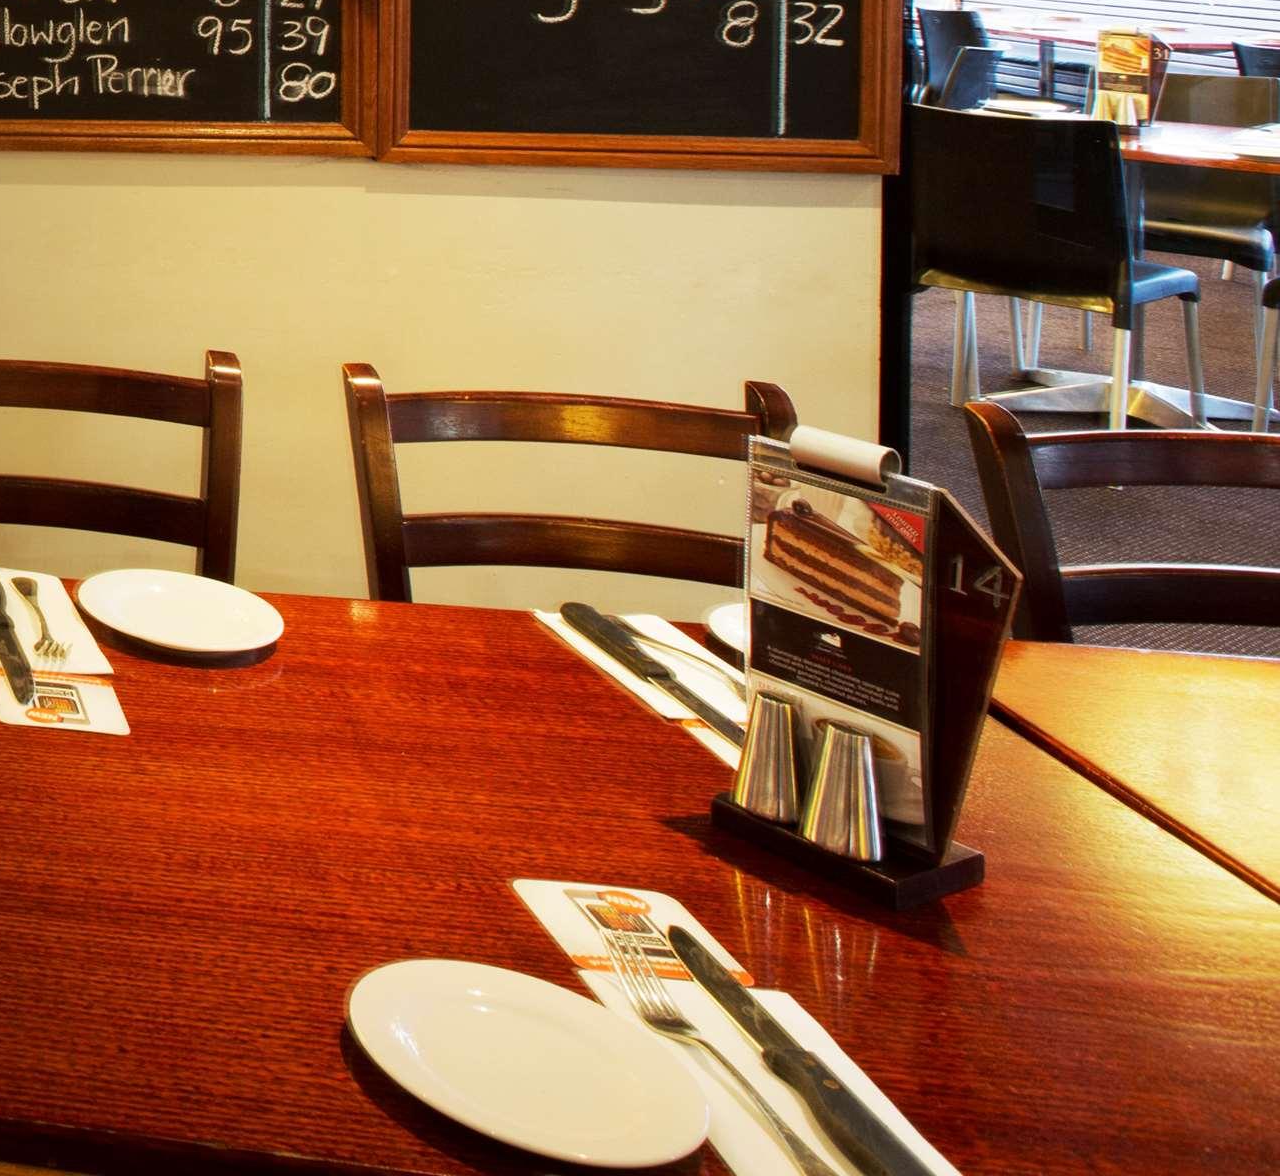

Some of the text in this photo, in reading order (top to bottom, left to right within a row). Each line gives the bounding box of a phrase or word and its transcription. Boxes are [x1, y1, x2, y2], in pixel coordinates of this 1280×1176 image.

[280, 15, 330, 55] 39
[720, 1, 845, 47] 8 32
[280, 62, 336, 101] 80
[948, 555, 1009, 608] 14
